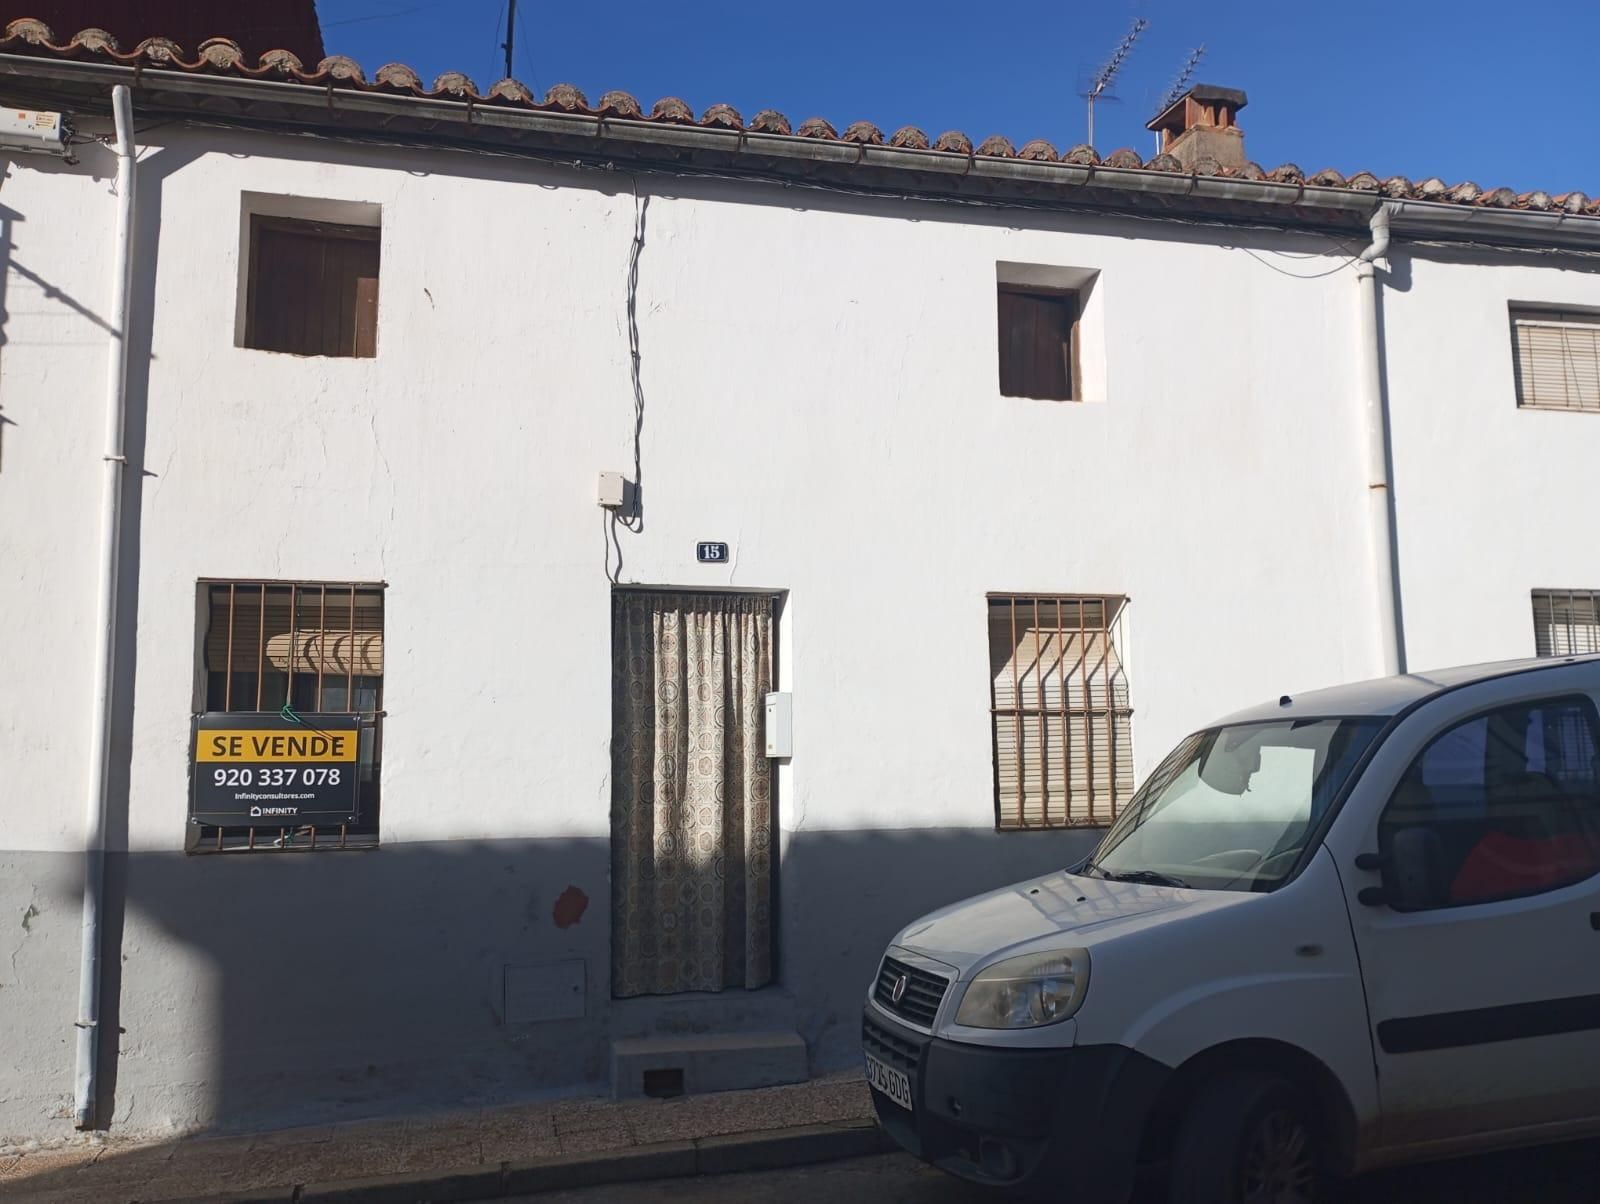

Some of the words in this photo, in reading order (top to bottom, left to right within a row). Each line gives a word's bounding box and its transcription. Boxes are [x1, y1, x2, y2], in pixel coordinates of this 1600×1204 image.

[704, 545, 720, 559] 15
[212, 736, 243, 757] SE
[252, 736, 345, 757] VENDE
[214, 769, 252, 786] 920
[258, 769, 297, 786] 337
[303, 769, 340, 786] 078
[234, 792, 315, 800] Infinityconsultores.com
[889, 1070, 909, 1104] GDG
